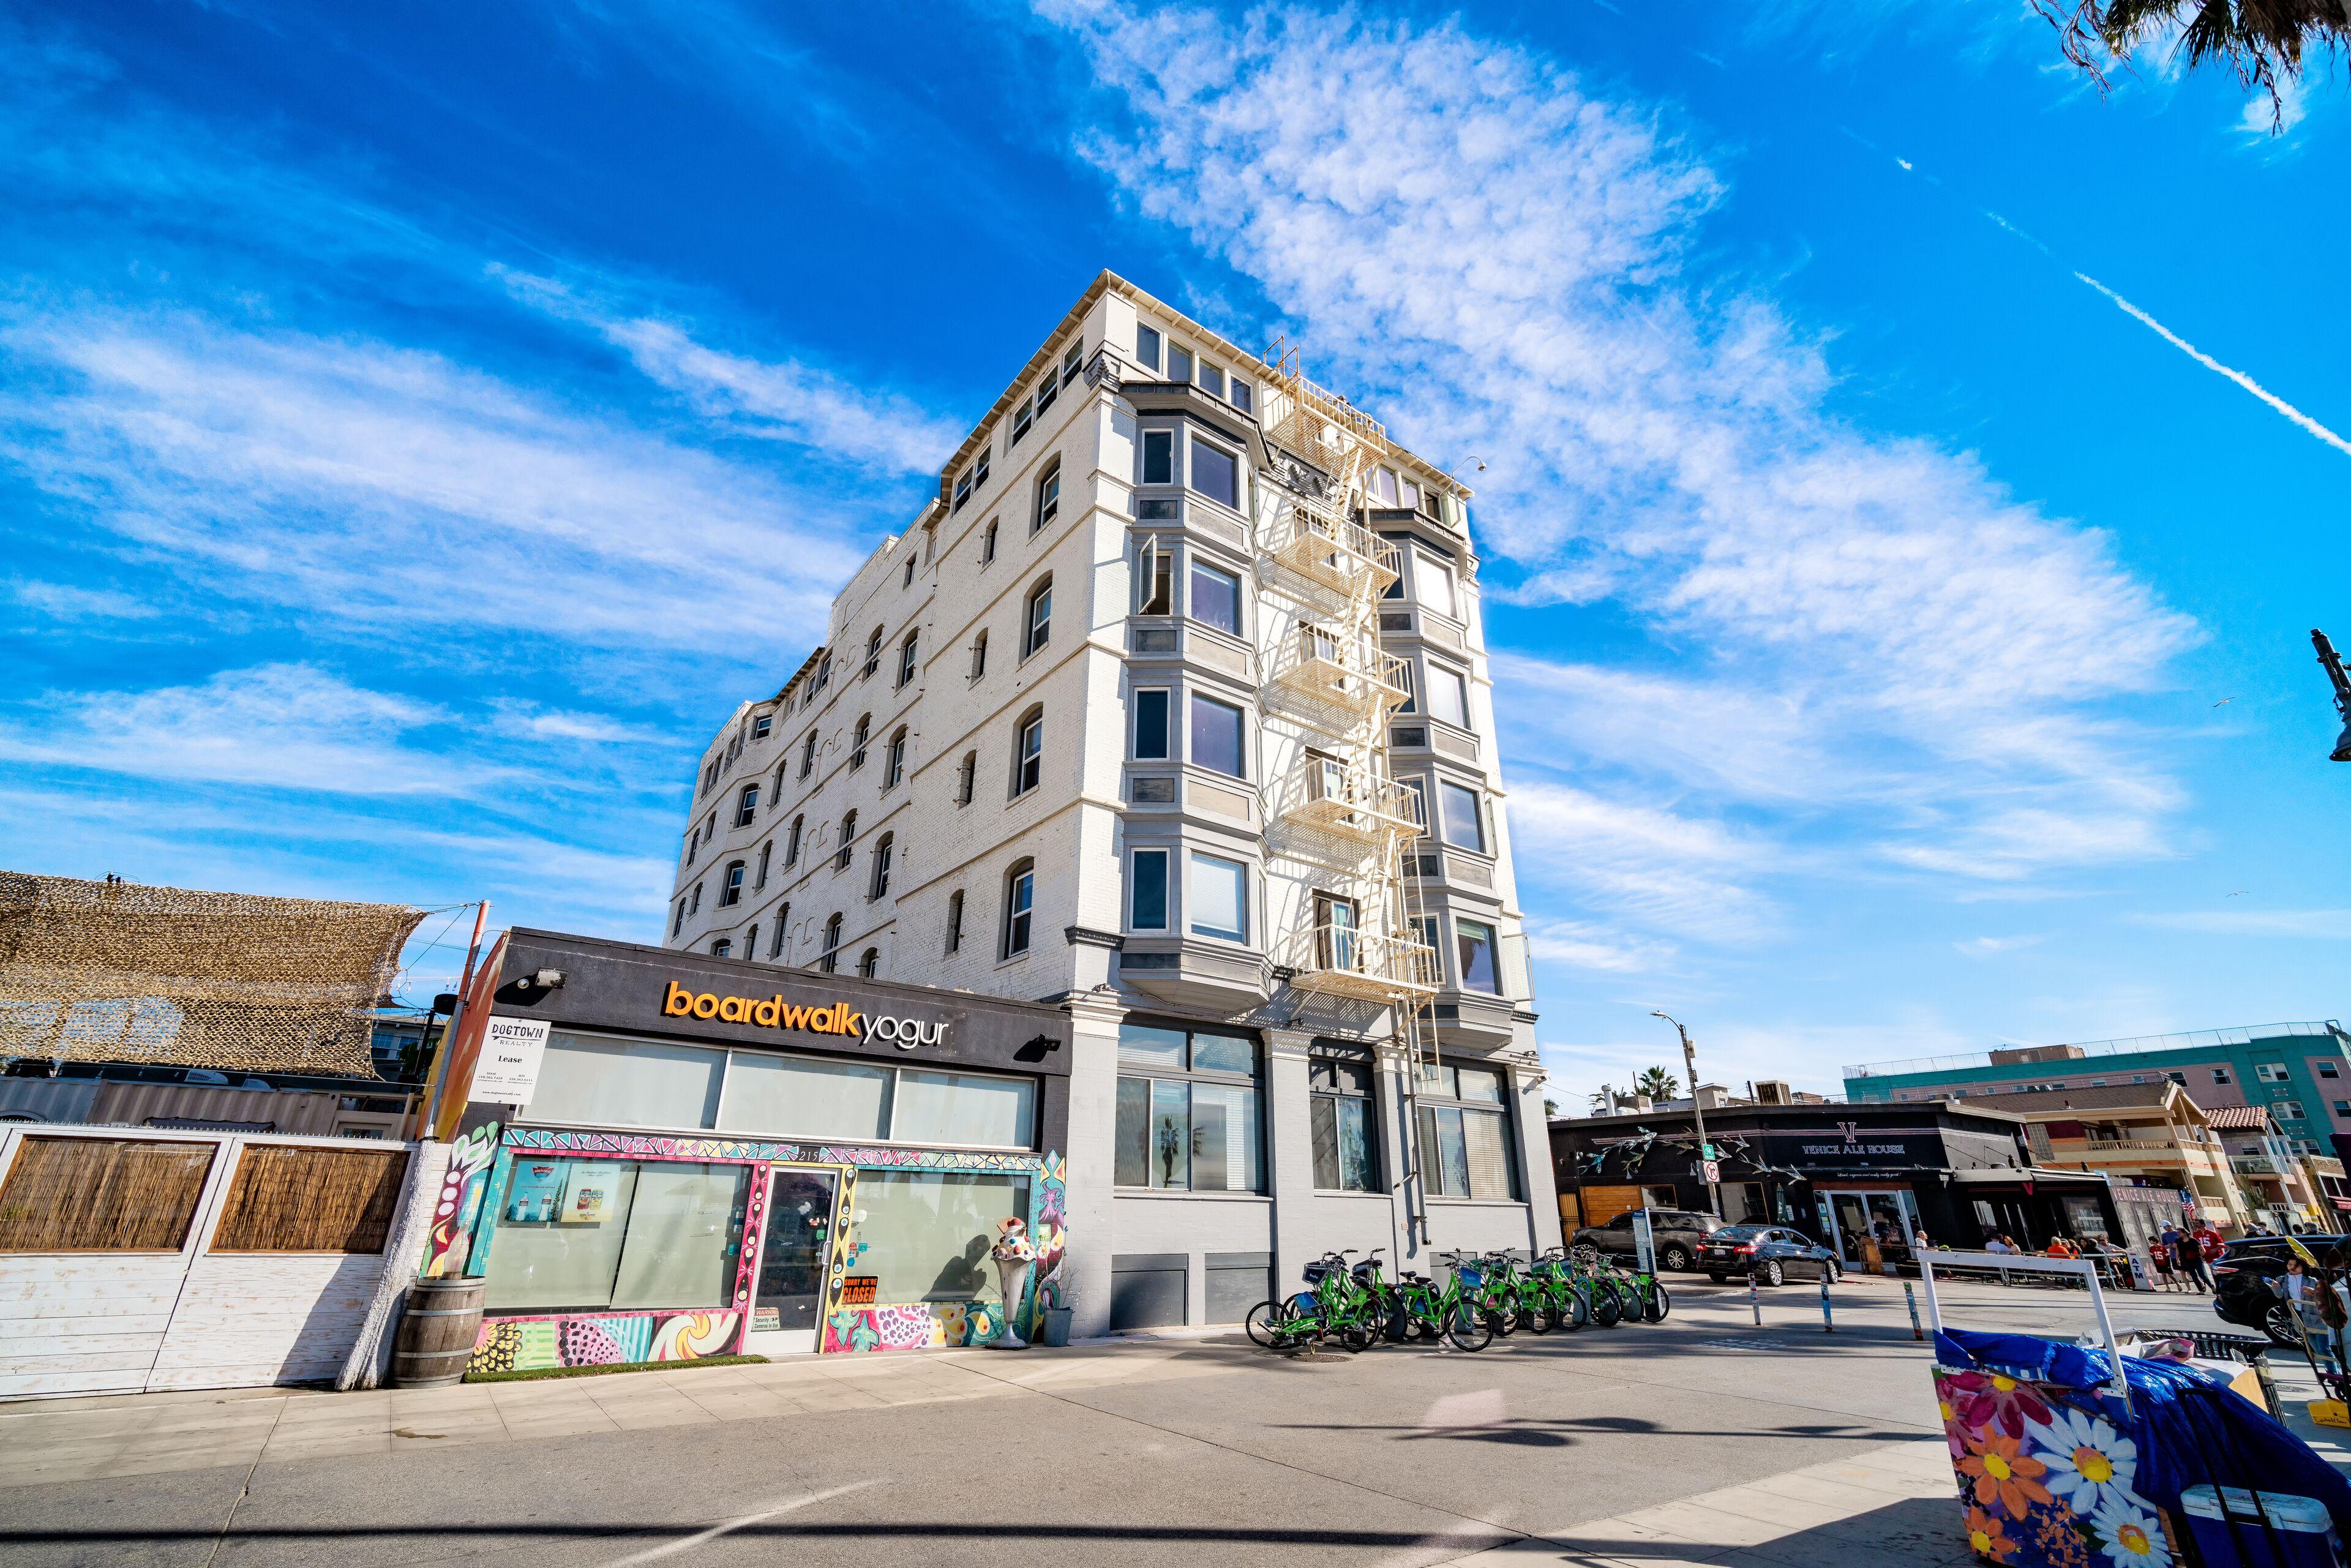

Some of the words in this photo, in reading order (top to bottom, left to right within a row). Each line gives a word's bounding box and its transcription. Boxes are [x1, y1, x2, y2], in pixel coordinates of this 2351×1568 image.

[491, 1024, 544, 1038] DOGTOWN
[498, 1055, 522, 1063] Lease
[1837, 1122, 1857, 1143] V
[1802, 1145, 1840, 1155] VENICE
[1843, 1145, 1865, 1155] ALE
[1867, 1144, 1905, 1154] HOUSE
[798, 1151, 819, 1161] 215
[2112, 1188, 2140, 1201] VENICE
[2141, 1189, 2155, 1202] ALE
[2155, 1190, 2180, 1203] HOUSE
[2198, 1237, 2211, 1247] 15
[2153, 1251, 2164, 1260] 15
[2131, 1258, 2144, 1279] ATM
[842, 1286, 876, 1304] CLOSED
